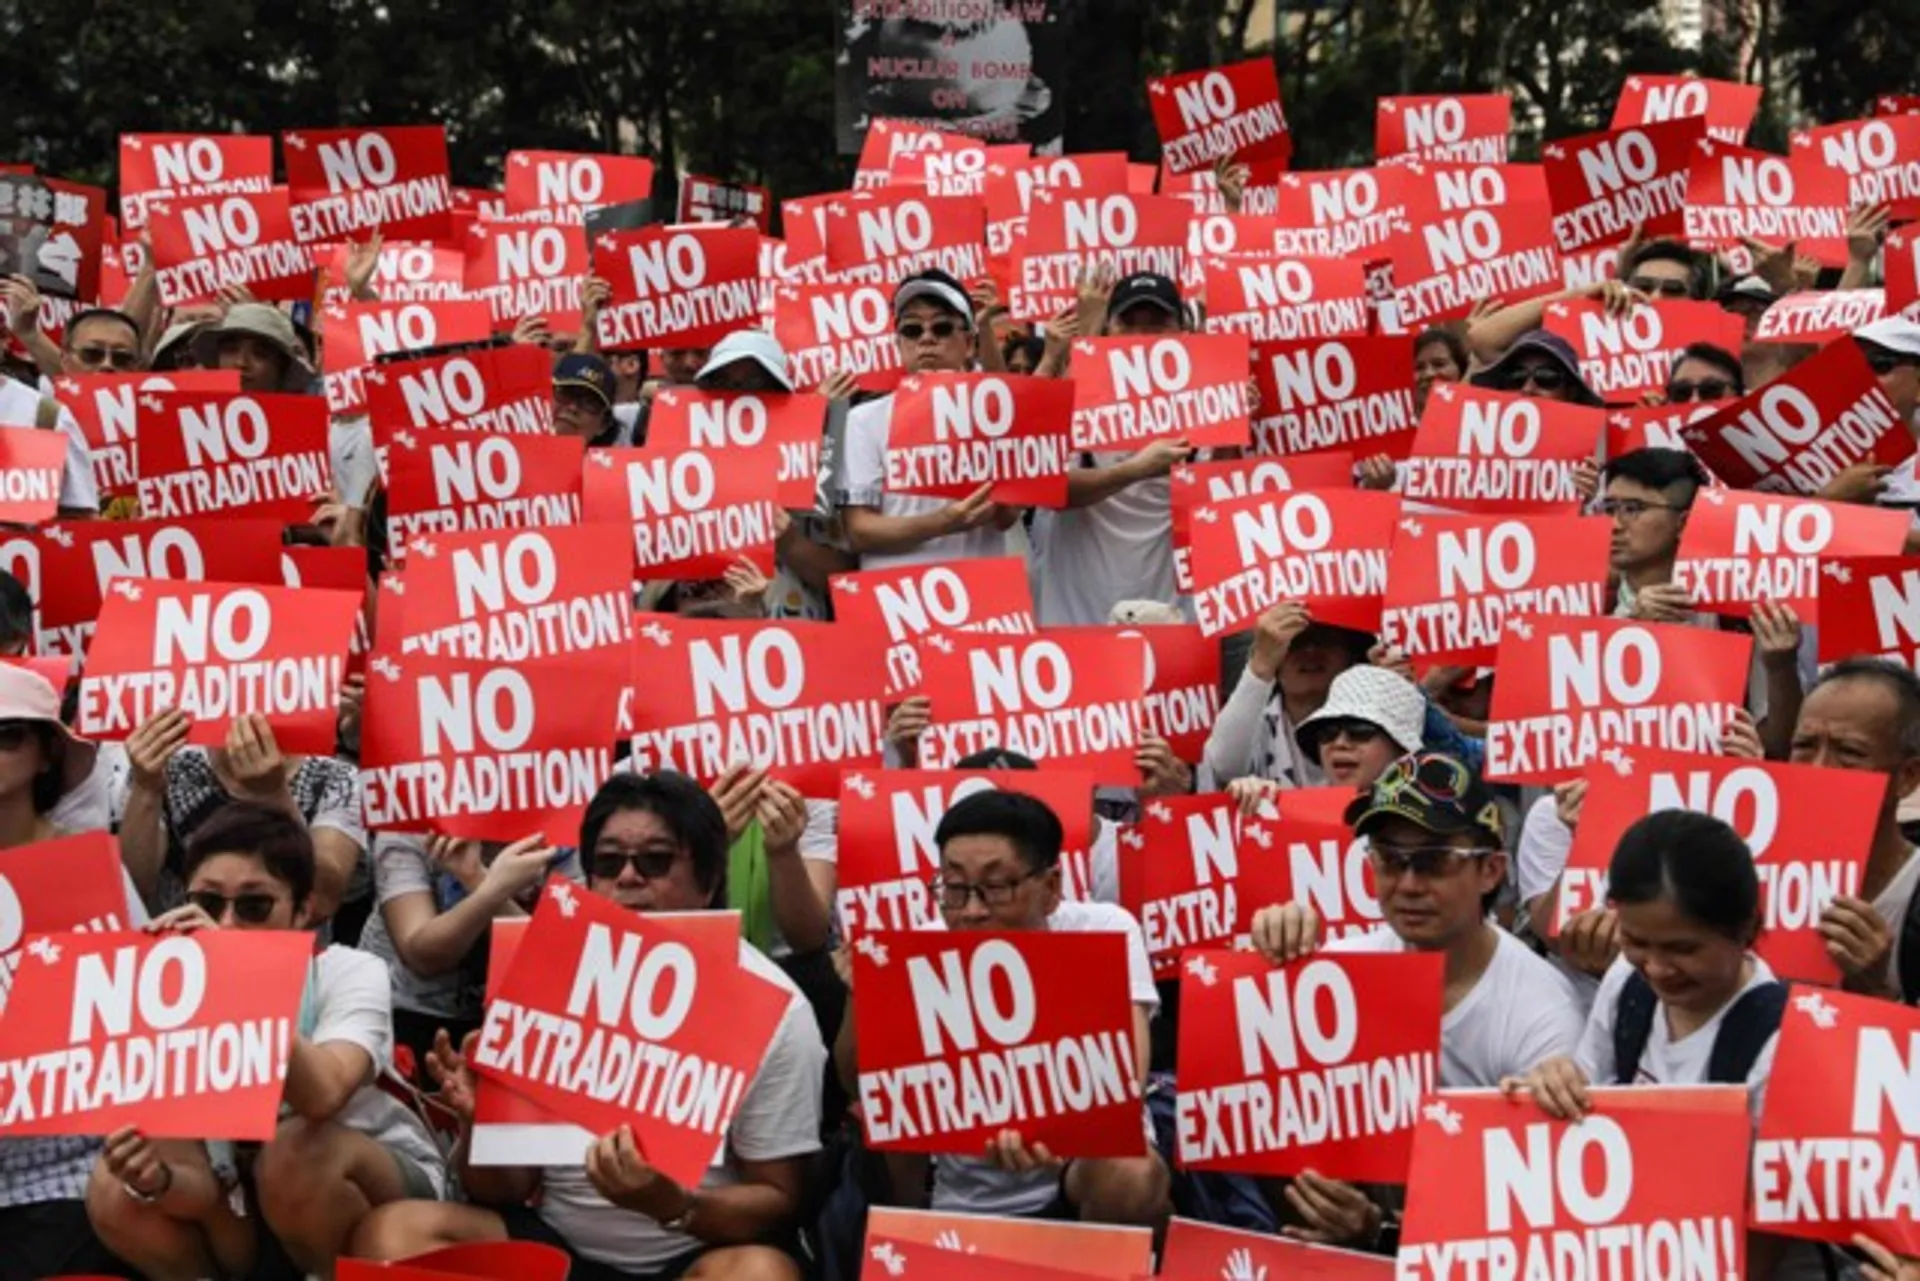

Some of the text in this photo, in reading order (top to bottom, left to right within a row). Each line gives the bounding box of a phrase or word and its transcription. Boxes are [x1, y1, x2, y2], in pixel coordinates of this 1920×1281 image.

[867, 57, 959, 78] NUCLEAR
[1172, 71, 1238, 133] NO
[1404, 97, 1467, 153] NO
[1641, 81, 1709, 124] NO
[151, 138, 224, 188] NO
[317, 133, 397, 195] NO
[924, 148, 985, 178] NO
[1577, 129, 1658, 200] NO
[1720, 155, 1795, 207] NO
[1821, 119, 1898, 175] NO
[290, 176, 454, 241] EXTRADITION!
[537, 158, 604, 206] NO
[1308, 173, 1379, 227] NO
[1434, 166, 1507, 211] NO
[182, 197, 260, 257] NO
[497, 227, 567, 281] NO
[858, 199, 931, 260] NO
[1063, 194, 1138, 251] NO
[1422, 208, 1502, 272] NO
[1683, 204, 1847, 239] EXTRADITION!
[628, 233, 707, 298] NO
[1237, 261, 1313, 310] NO
[1394, 245, 1559, 325] EXTRADITION!
[357, 304, 437, 362] NO
[597, 278, 761, 348] EXTRADITION!
[811, 288, 889, 342] NO
[1580, 302, 1664, 359] NO
[398, 356, 485, 429] NO
[1108, 337, 1192, 401] NO
[1271, 341, 1357, 410] NO
[178, 396, 270, 468] NO
[689, 394, 768, 449] NO
[931, 377, 1014, 442] NO
[1071, 380, 1254, 450] EXTRADITION!
[1251, 387, 1419, 457] XTRADITION!
[1458, 400, 1542, 457] NO
[1718, 383, 1822, 474] NO
[138, 450, 333, 520] EXTRADITION!
[430, 436, 522, 506] NO
[627, 450, 716, 521] NO
[886, 433, 1072, 493] EXTRADITION!
[633, 500, 777, 568] RADITION!
[1231, 493, 1333, 567] NO
[1436, 520, 1537, 598] NO
[1733, 503, 1834, 556] NO
[452, 532, 557, 620] NO
[873, 566, 972, 643] NO
[153, 589, 272, 667] NO
[80, 655, 343, 735] EXTRADITION!
[688, 626, 806, 718] NO
[968, 641, 1074, 716] NO
[1547, 626, 1662, 709] NO
[417, 666, 537, 756] NO
[917, 697, 1143, 771] EXTRADITION!
[361, 745, 611, 827] EXTRADITION!
[69, 934, 207, 1046] NO
[565, 920, 699, 1042] NO
[907, 938, 1036, 1057] NO
[1232, 959, 1359, 1077] NO
[475, 998, 747, 1137] EXTRADITION!
[858, 1029, 1142, 1143] EXTRADITION!
[1175, 1051, 1434, 1163] EXTRADITION!
[1482, 1114, 1634, 1233] NO
